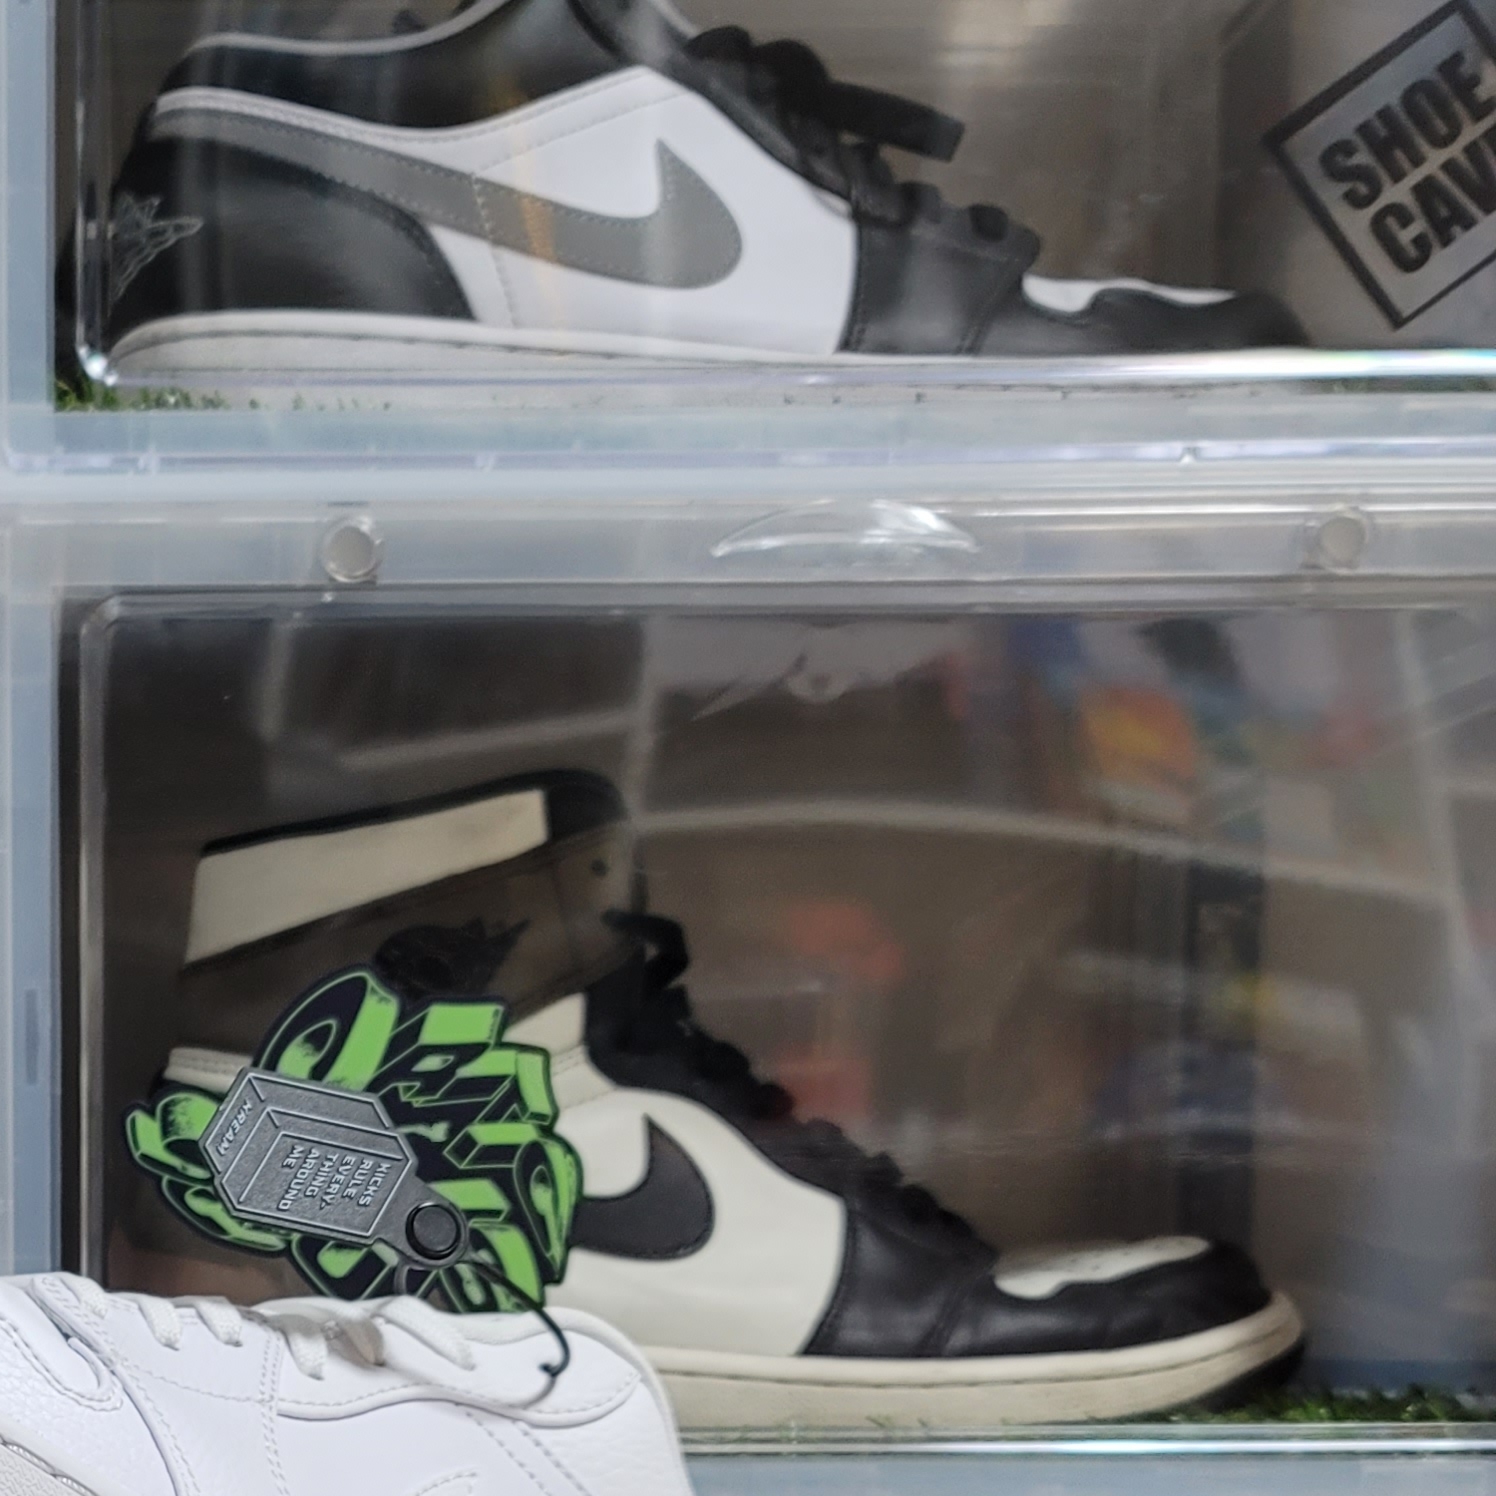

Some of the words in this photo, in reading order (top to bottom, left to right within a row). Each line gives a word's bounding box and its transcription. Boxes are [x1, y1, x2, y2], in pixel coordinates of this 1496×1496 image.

[1318, 50, 1496, 210] SHOE
[1370, 122, 1496, 273] CAV
[216, 1100, 253, 1157] KREAM
[278, 1148, 319, 1211] AROUND
[281, 1144, 306, 1168] ME
[305, 1153, 338, 1198] THING
[341, 1159, 374, 1200] RULE
[358, 1162, 392, 1207] KICKS
